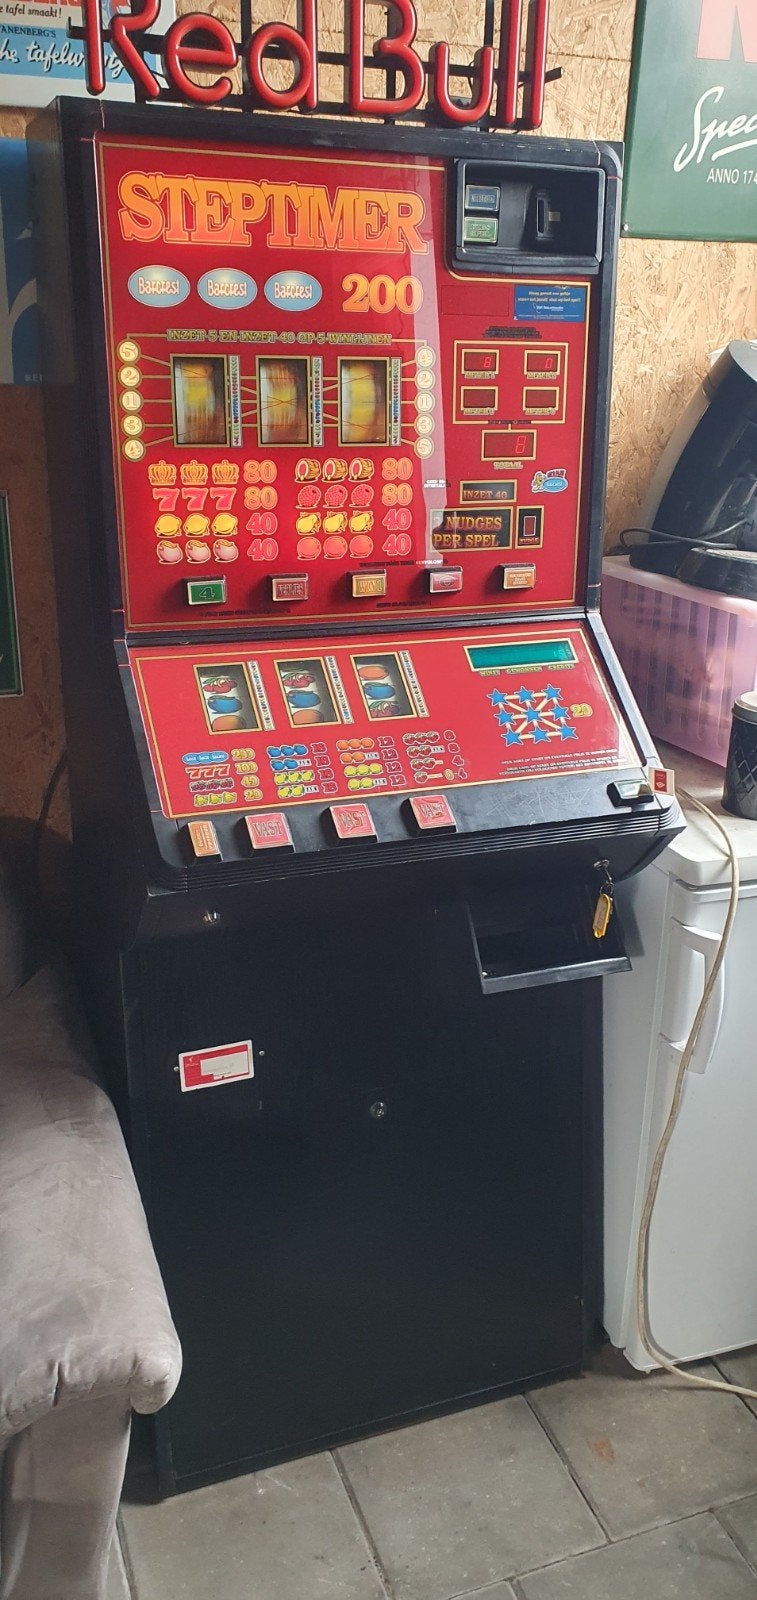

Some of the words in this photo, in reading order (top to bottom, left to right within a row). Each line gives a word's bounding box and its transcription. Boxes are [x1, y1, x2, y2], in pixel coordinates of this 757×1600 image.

[5, 3, 26, 16] tafel
[86, 0, 318, 113] Red
[350, 0, 549, 128] Bull
[706, 168, 739, 184] ANNO
[118, 170, 429, 255] STEPTIMER
[137, 276, 181, 295] Barcrest
[206, 278, 247, 298] Barcrest
[273, 282, 313, 300] Barcrest
[341, 273, 424, 314] 200
[168, 329, 205, 342] INZET
[240, 330, 277, 343] INZET
[120, 342, 136, 358] 5
[123, 369, 138, 385] 2
[125, 393, 138, 409] 1
[419, 395, 431, 410] 1
[127, 418, 140, 433] 3
[127, 443, 141, 458] 4
[244, 459, 277, 483] 80
[381, 457, 413, 480] 80
[153, 487, 180, 511] 7
[181, 487, 208, 511] 7
[210, 487, 236, 511] 7
[244, 485, 278, 510] 80
[381, 483, 412, 506] 80
[463, 490, 493, 499] INZET
[246, 512, 278, 535] 40
[382, 508, 412, 530] 40
[446, 516, 502, 531] NUDGES
[382, 534, 412, 556] 40
[433, 534, 461, 548] PER
[465, 533, 500, 548] SPEL
[247, 538, 279, 560] 40
[199, 586, 215, 600] 4
[338, 811, 365, 828] VAST
[252, 821, 282, 838] VAST
